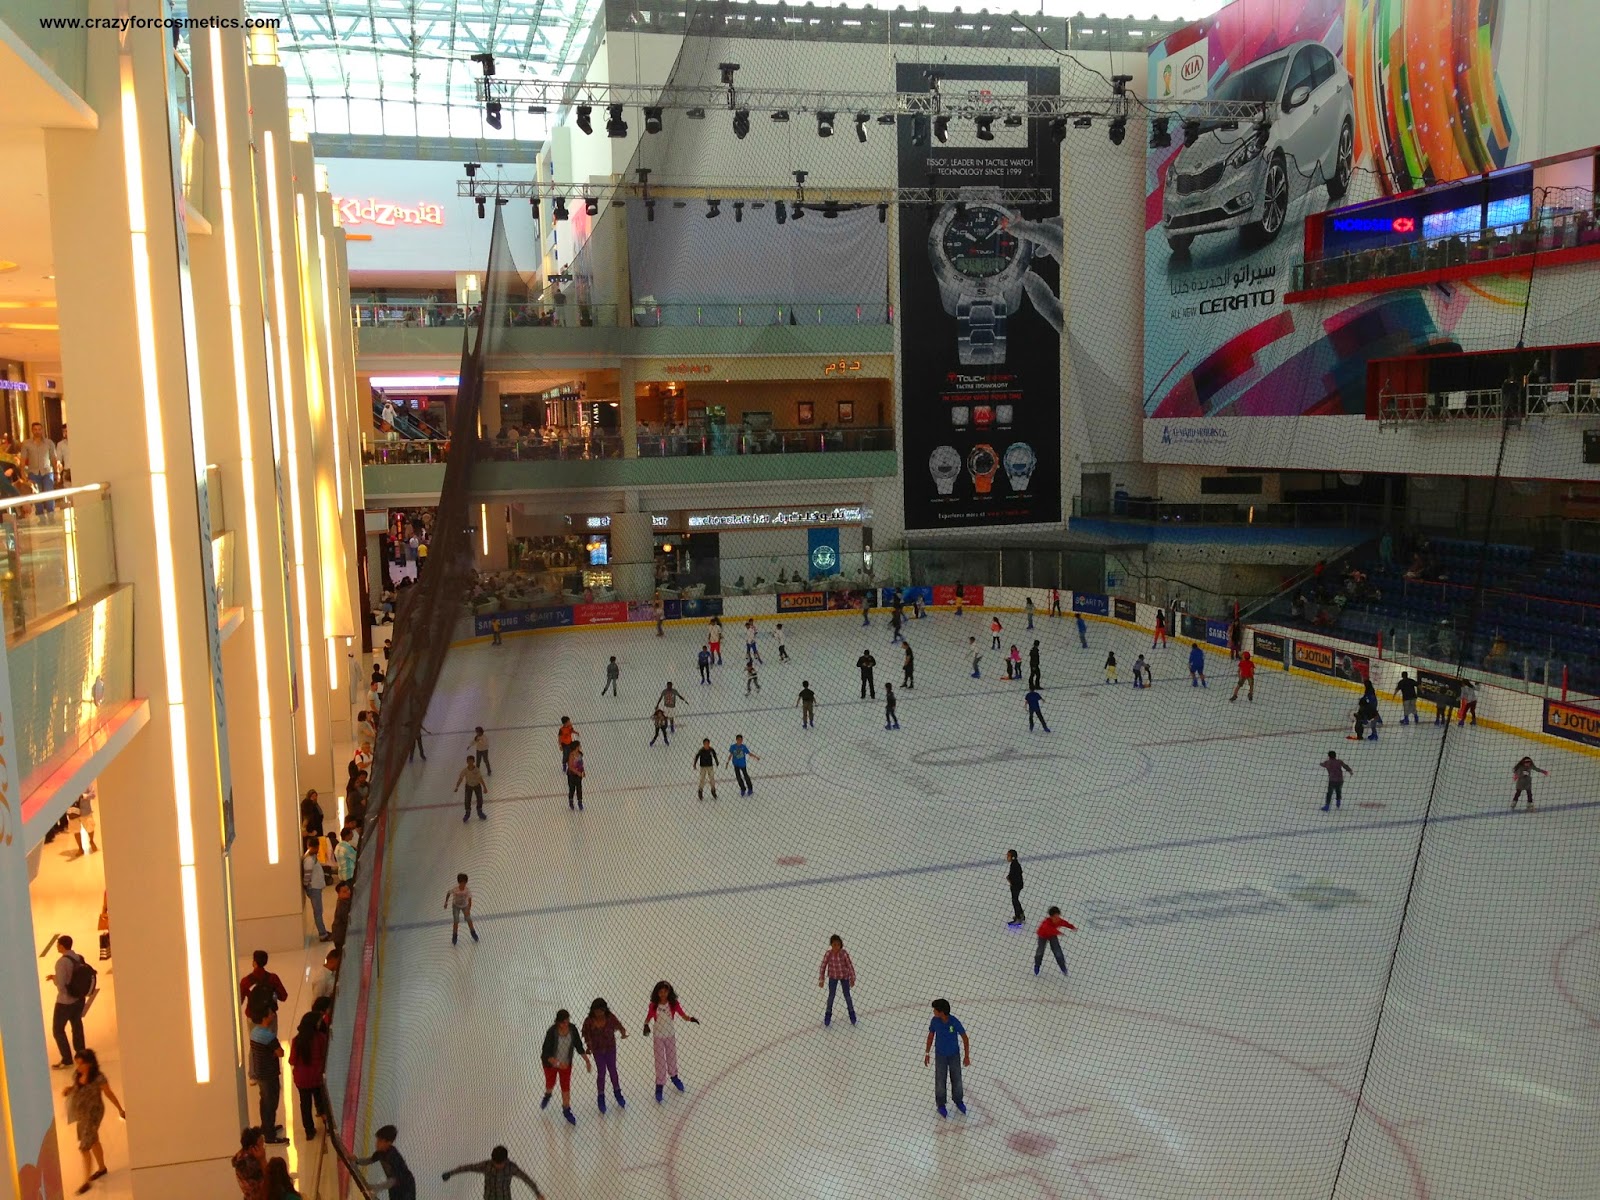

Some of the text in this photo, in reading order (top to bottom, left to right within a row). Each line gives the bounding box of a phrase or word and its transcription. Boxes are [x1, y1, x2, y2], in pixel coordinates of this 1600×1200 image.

[1185, 59, 1200, 77] KIA
[951, 158, 974, 167] LEADER
[976, 158, 984, 167] IN
[985, 158, 1008, 167] TACTILE
[1010, 158, 1033, 167] WATCH
[938, 167, 1022, 176] TECHNOLOGY SINCE 1999
[332, 197, 442, 225] KidZania
[1233, 264, 1276, 289] سيراتو
[1199, 289, 1275, 315] CERATO
[792, 596, 822, 606] JOTUN
[1075, 597, 1096, 607] SART
[478, 616, 518, 629] SAUNG
[525, 613, 553, 623] SART
[1208, 627, 1229, 641] SAMS
[1304, 650, 1331, 666] JOTUN
